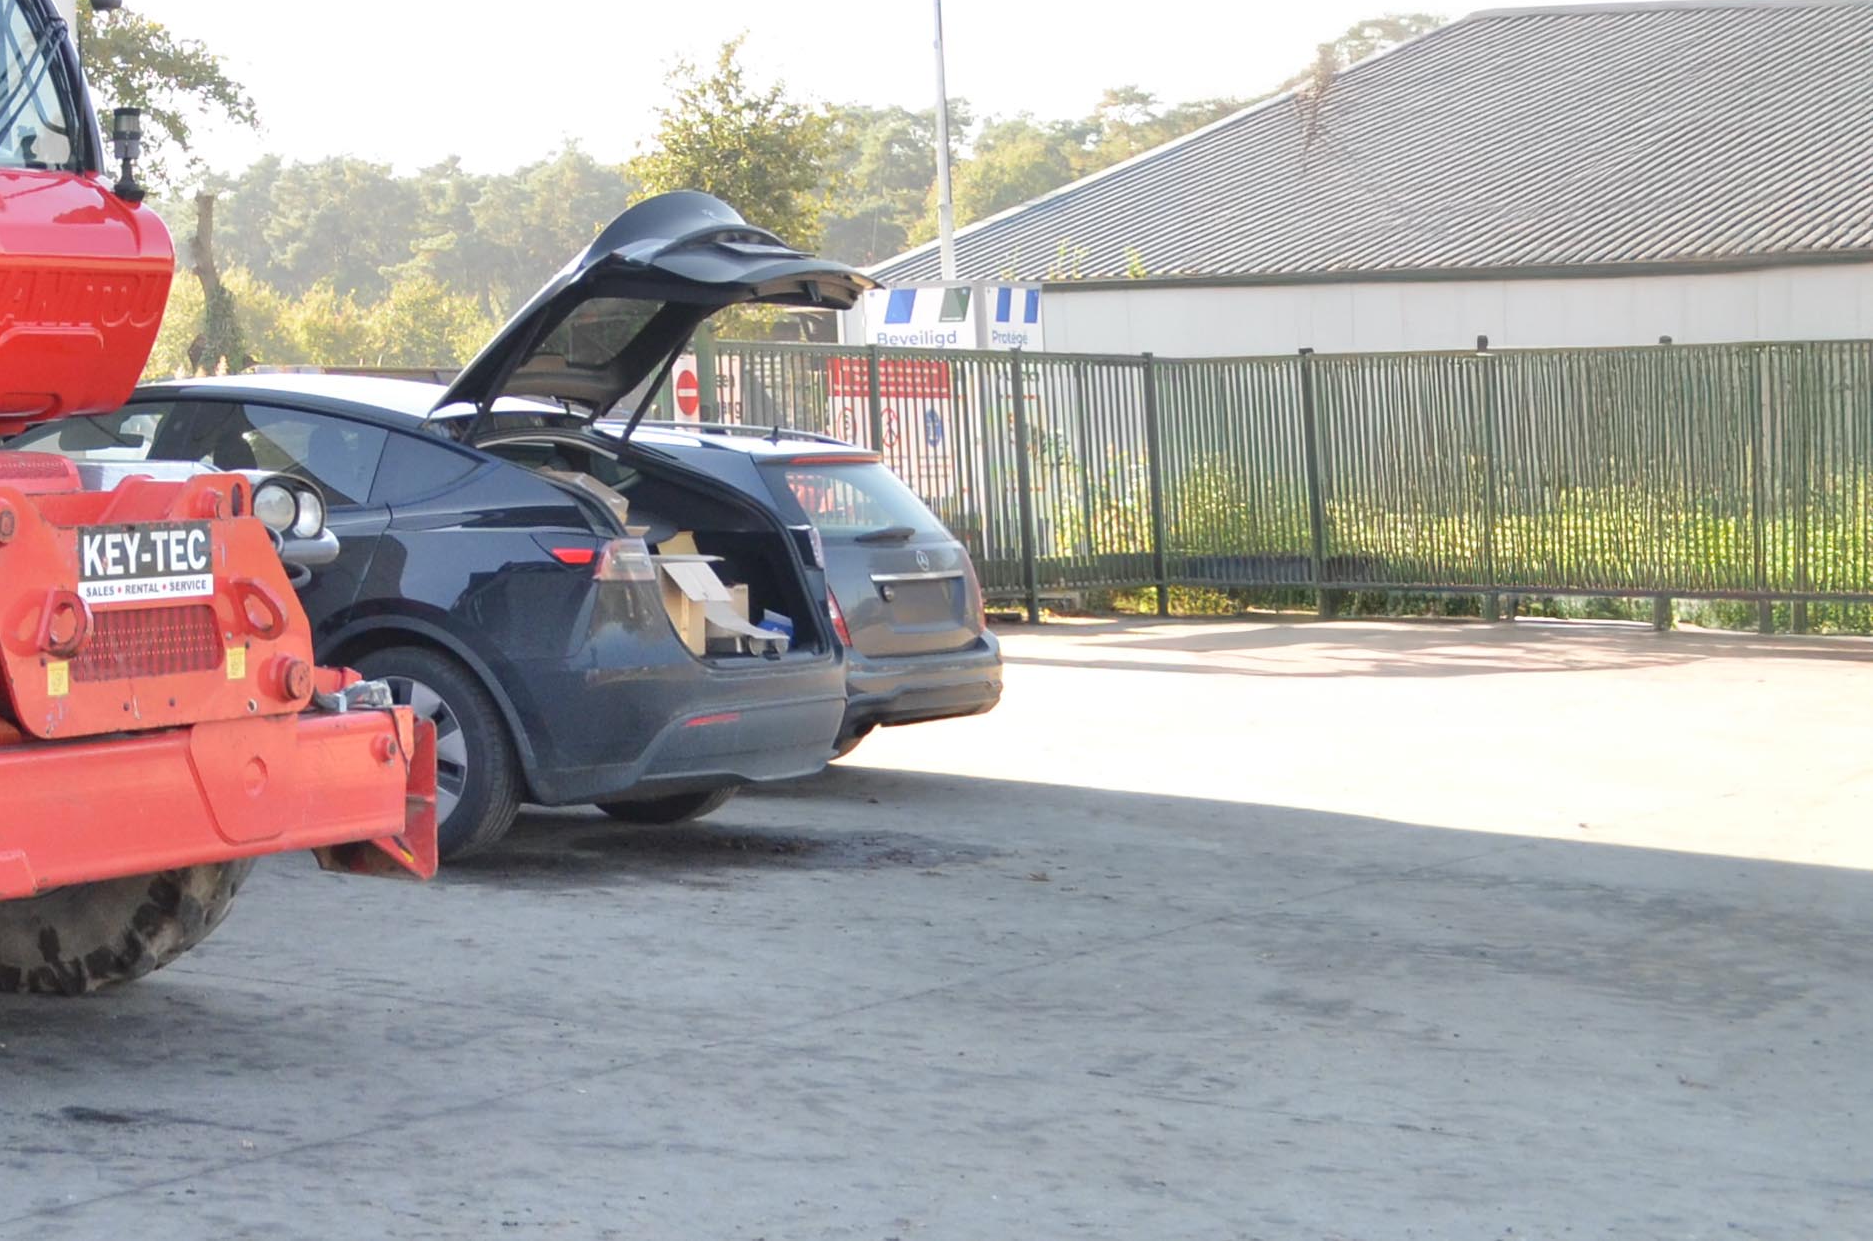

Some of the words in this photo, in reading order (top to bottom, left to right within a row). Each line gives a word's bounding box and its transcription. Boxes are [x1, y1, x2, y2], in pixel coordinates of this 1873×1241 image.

[877, 330, 957, 347] Beveiligd
[83, 529, 207, 577] KEY-TEC
[86, 585, 115, 598] SALES
[125, 583, 159, 595] RENTAL
[169, 579, 207, 592] SERVICE
